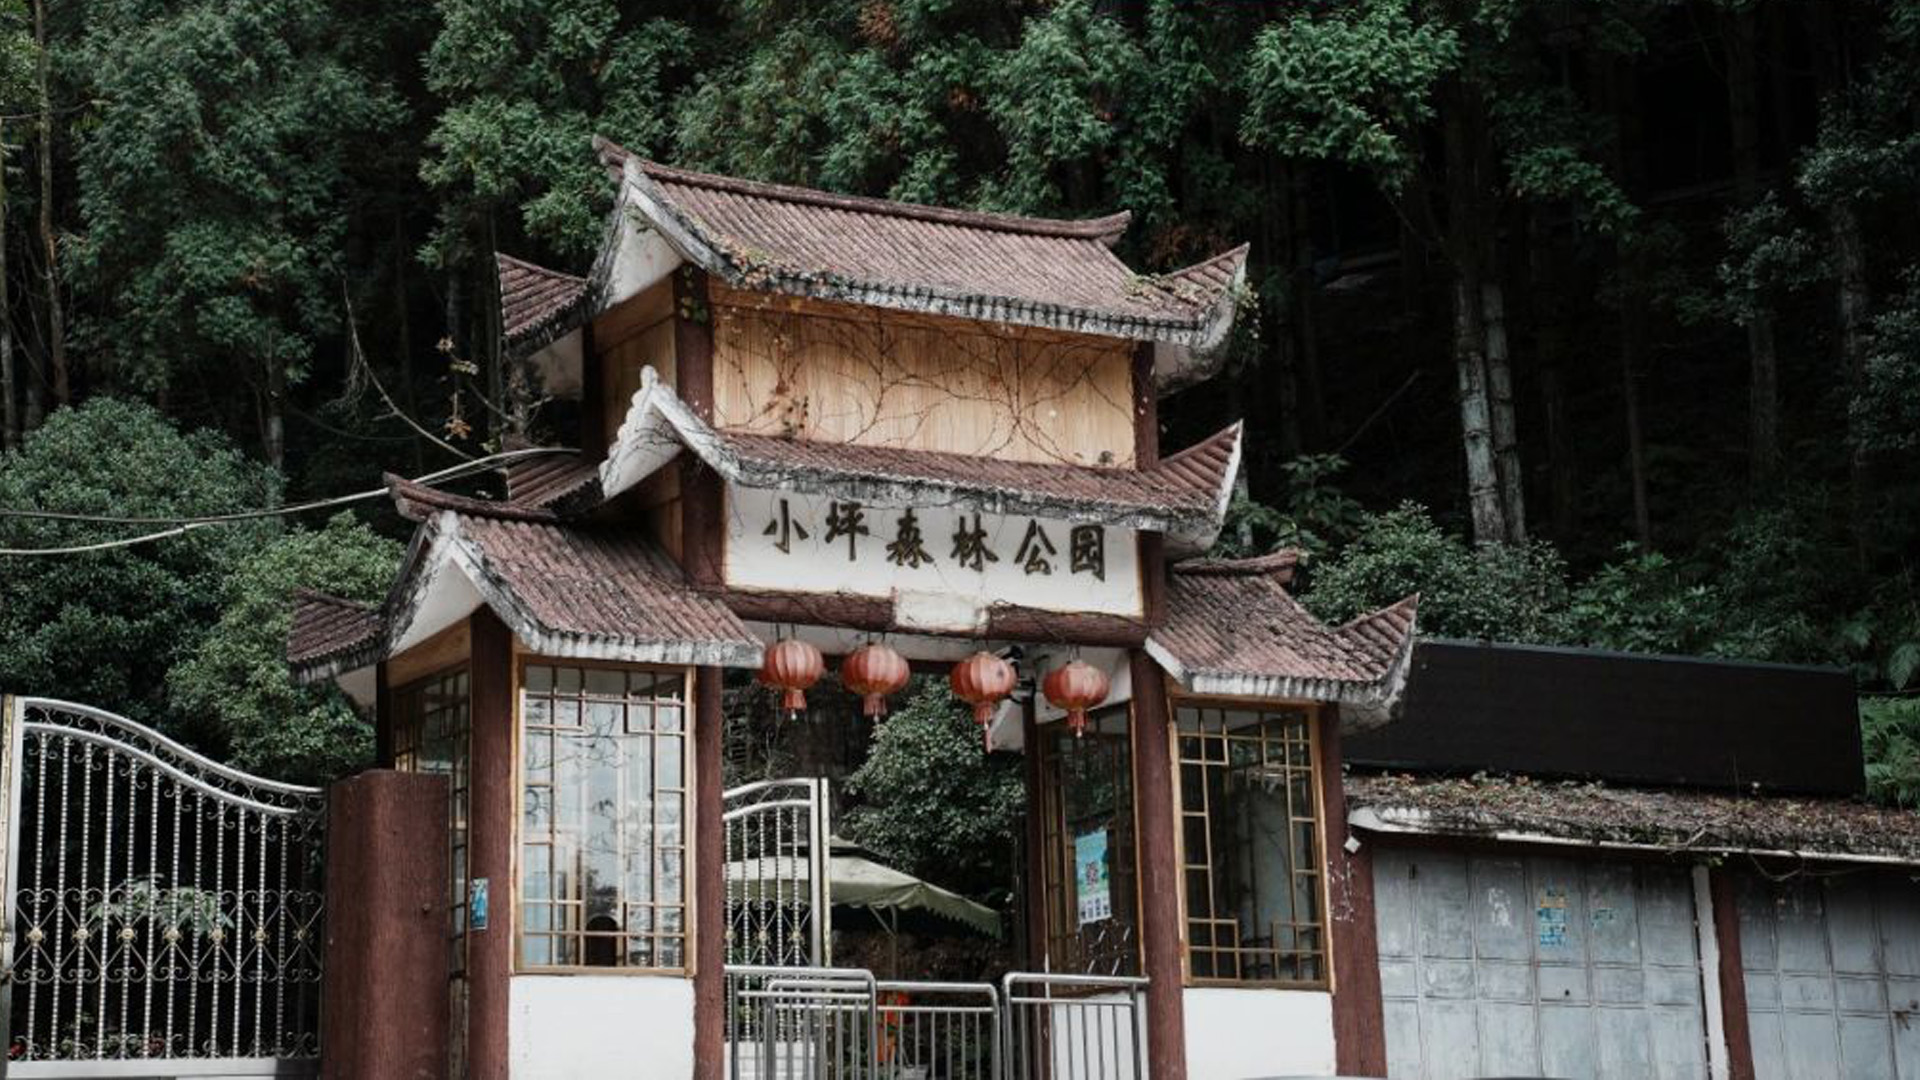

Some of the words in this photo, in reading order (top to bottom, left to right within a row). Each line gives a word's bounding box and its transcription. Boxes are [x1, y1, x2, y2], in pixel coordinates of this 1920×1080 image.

[763, 499, 1106, 581] 小坪森林公园
